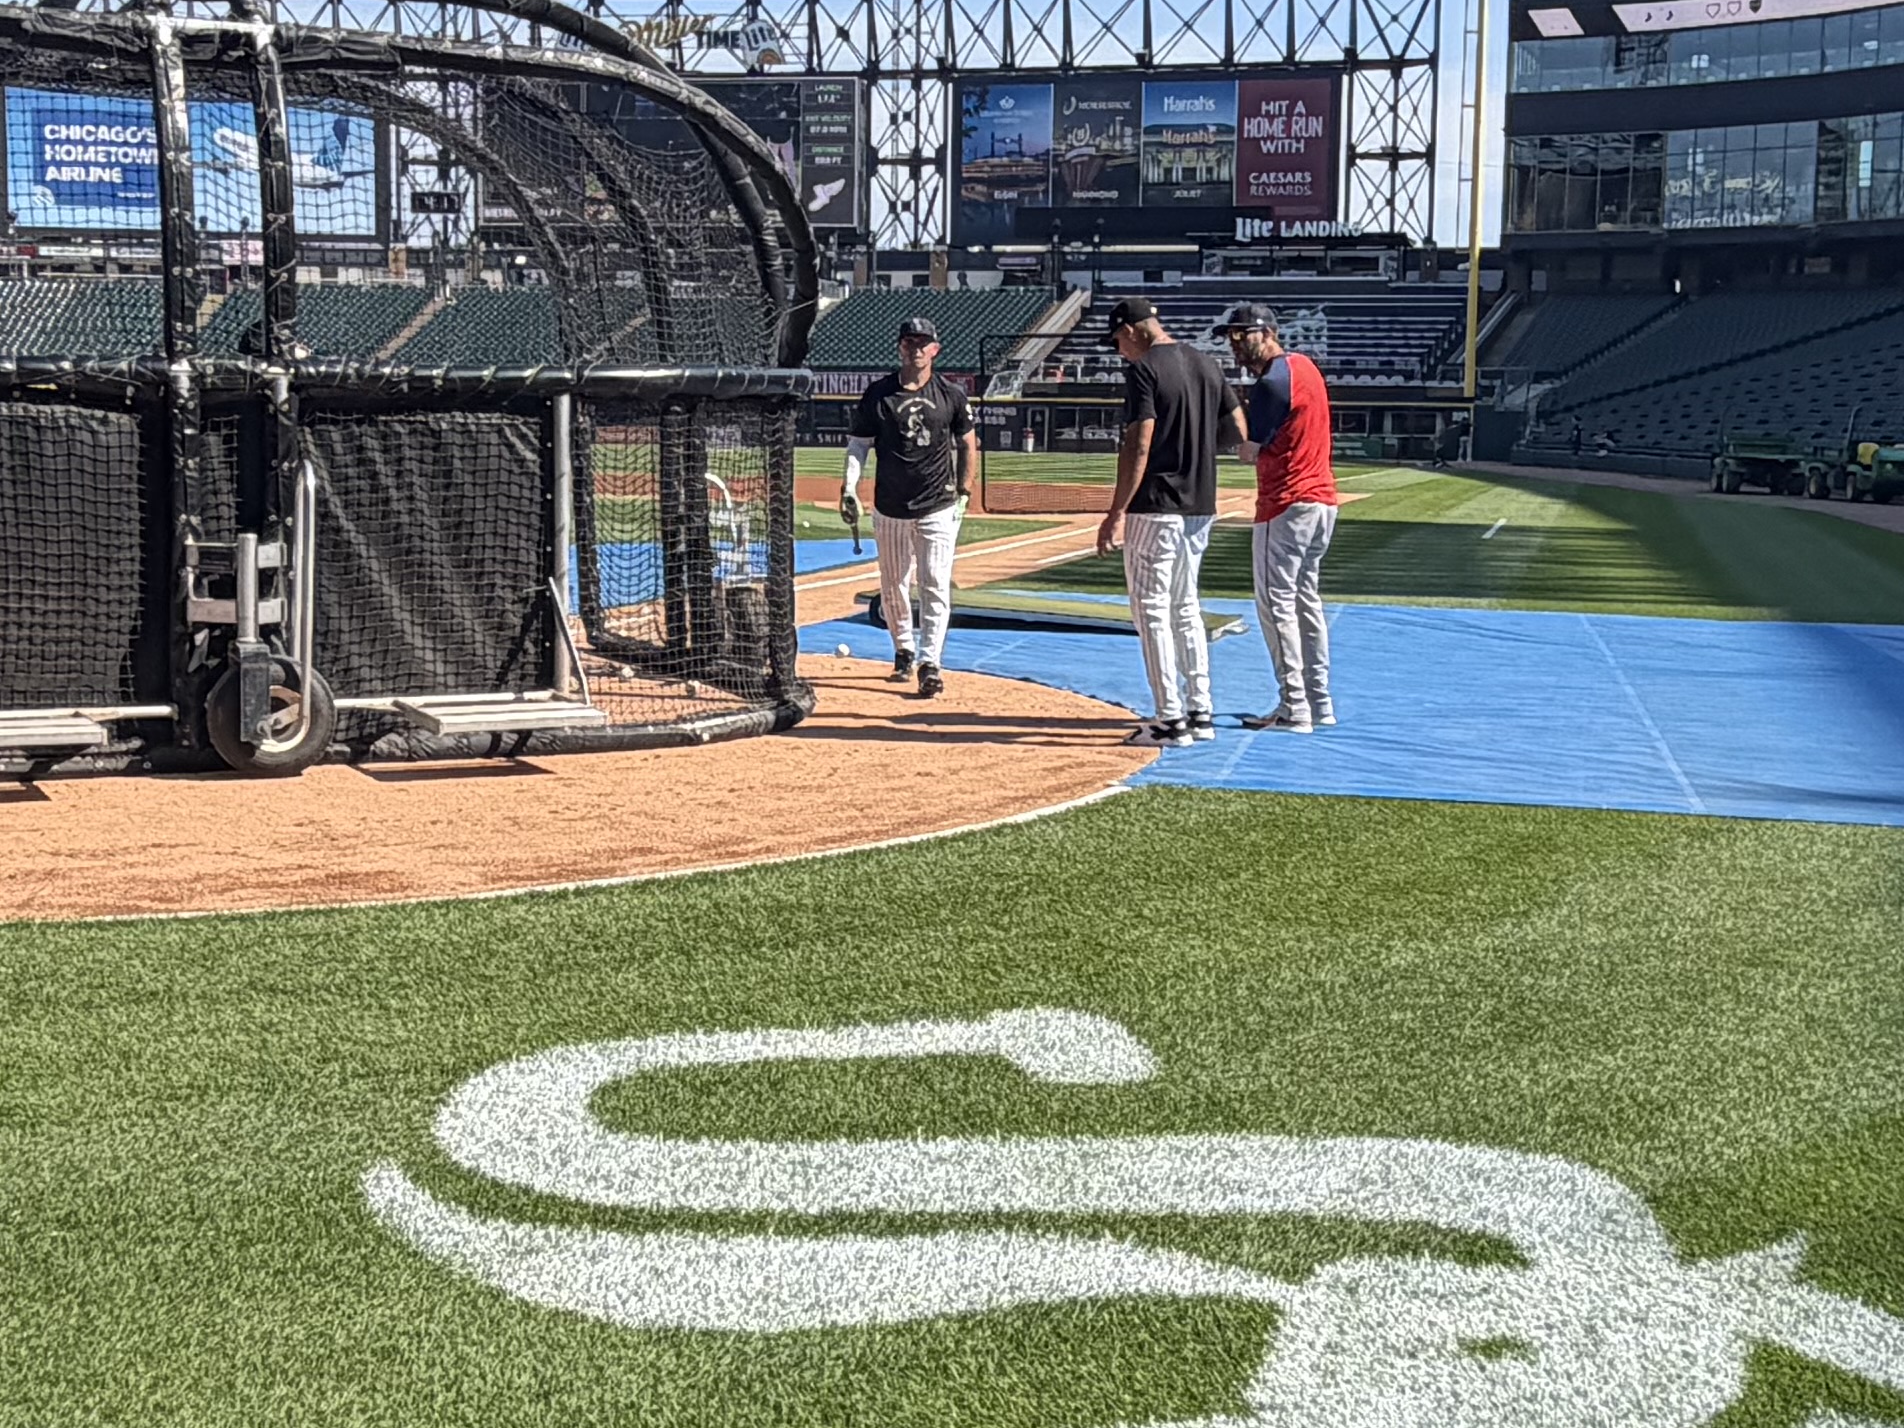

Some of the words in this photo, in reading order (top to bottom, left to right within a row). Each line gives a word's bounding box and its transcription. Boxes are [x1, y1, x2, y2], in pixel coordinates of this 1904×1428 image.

[694, 29, 741, 49] TIME
[1261, 101, 1290, 115] HIT
[1293, 100, 1306, 114] A
[44, 124, 157, 144] CHICAGO'S
[1243, 117, 1288, 138] HOME
[1291, 116, 1323, 138] RUN
[1260, 139, 1305, 154] WITH
[44, 166, 123, 184] AIRLINE
[1249, 172, 1312, 184] CAESARS
[1249, 184, 1313, 196] REWARDS
[1235, 217, 1274, 242] Lite
[1280, 220, 1363, 238] LANDING
